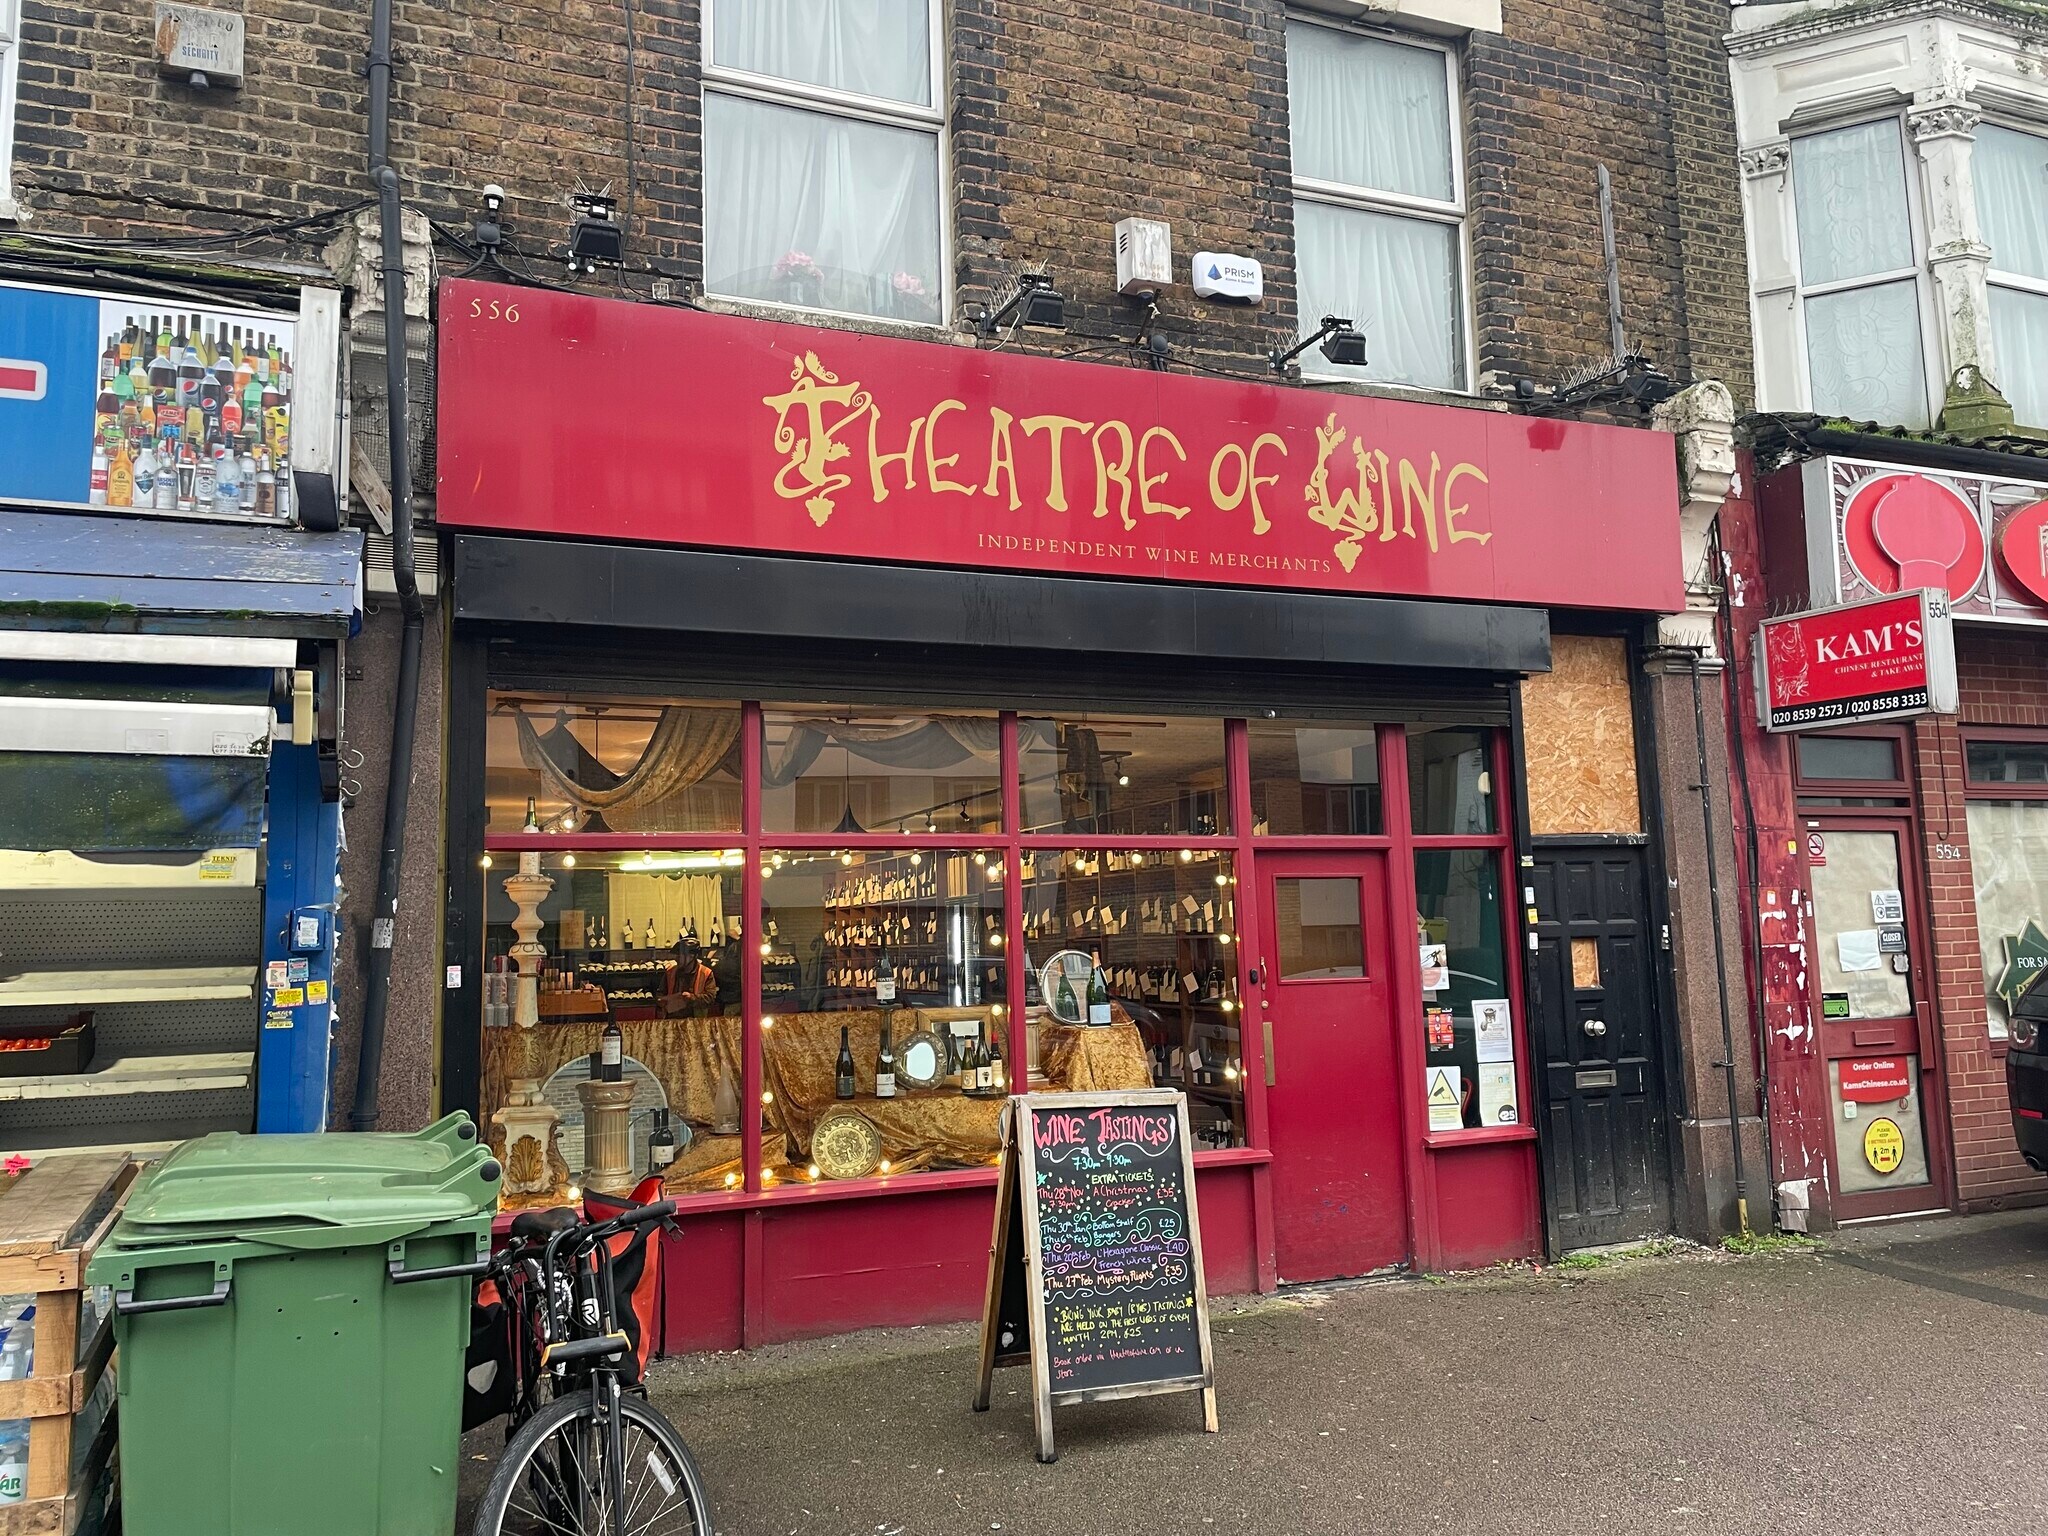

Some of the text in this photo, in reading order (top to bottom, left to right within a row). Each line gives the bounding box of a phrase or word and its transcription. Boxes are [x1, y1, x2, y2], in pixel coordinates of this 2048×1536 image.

[182, 46, 219, 60] SECURITY
[1224, 267, 1255, 279] PRISM
[470, 298, 520, 323] 556
[763, 350, 1493, 574] THEATRE OF WINE
[977, 533, 1331, 574] INDEPENDENT WINE MERCHANTS
[1929, 601, 1948, 619] 554
[1815, 619, 1923, 664] KAM'S
[1834, 653, 1924, 675] CHINESE RESTAURANT
[1880, 667, 1901, 677] TAKE
[1901, 663, 1923, 673] AWAY
[1773, 712, 1791, 724] 020
[1792, 707, 1816, 721] 8539
[1818, 704, 1843, 718] 2573
[1852, 700, 1870, 713] 020
[1872, 696, 1899, 710] 8558
[1901, 692, 1927, 707] 3333
[1936, 843, 1961, 860] 554
[2017, 957, 2037, 969] FOR
[1853, 1061, 1895, 1072] Order Online
[1843, 1078, 1908, 1090] KamsChinese.co.uk
[1032, 1108, 1169, 1149] WINE TASTINGS
[1880, 1147, 1890, 1155] 2m
[1091, 1174, 1119, 1185] EXTRA
[1037, 1187, 1053, 1200] Thu
[1070, 1186, 1084, 1202] Nov
[1093, 1187, 1100, 1197] A
[1100, 1184, 1149, 1197] Christmas
[1156, 1187, 1175, 1199] £35
[1105, 1197, 1136, 1208] Cracker
[1041, 1216, 1176, 1235] Thu 30th Jan Bottom Shelf £25
[1043, 1230, 1122, 1244] Thu 6th Feb Bangers
[1044, 1251, 1062, 1264] Thu
[1078, 1250, 1091, 1262] Feb
[1166, 1242, 1184, 1253] £40
[1045, 1265, 1183, 1290] Thu 27th Feb Mystery Flights £35
[1060, 1321, 1074, 1335] ARE
[1076, 1321, 1095, 1331] HELD
[1098, 1320, 1108, 1329] ON
[1110, 1318, 1123, 1328] THE
